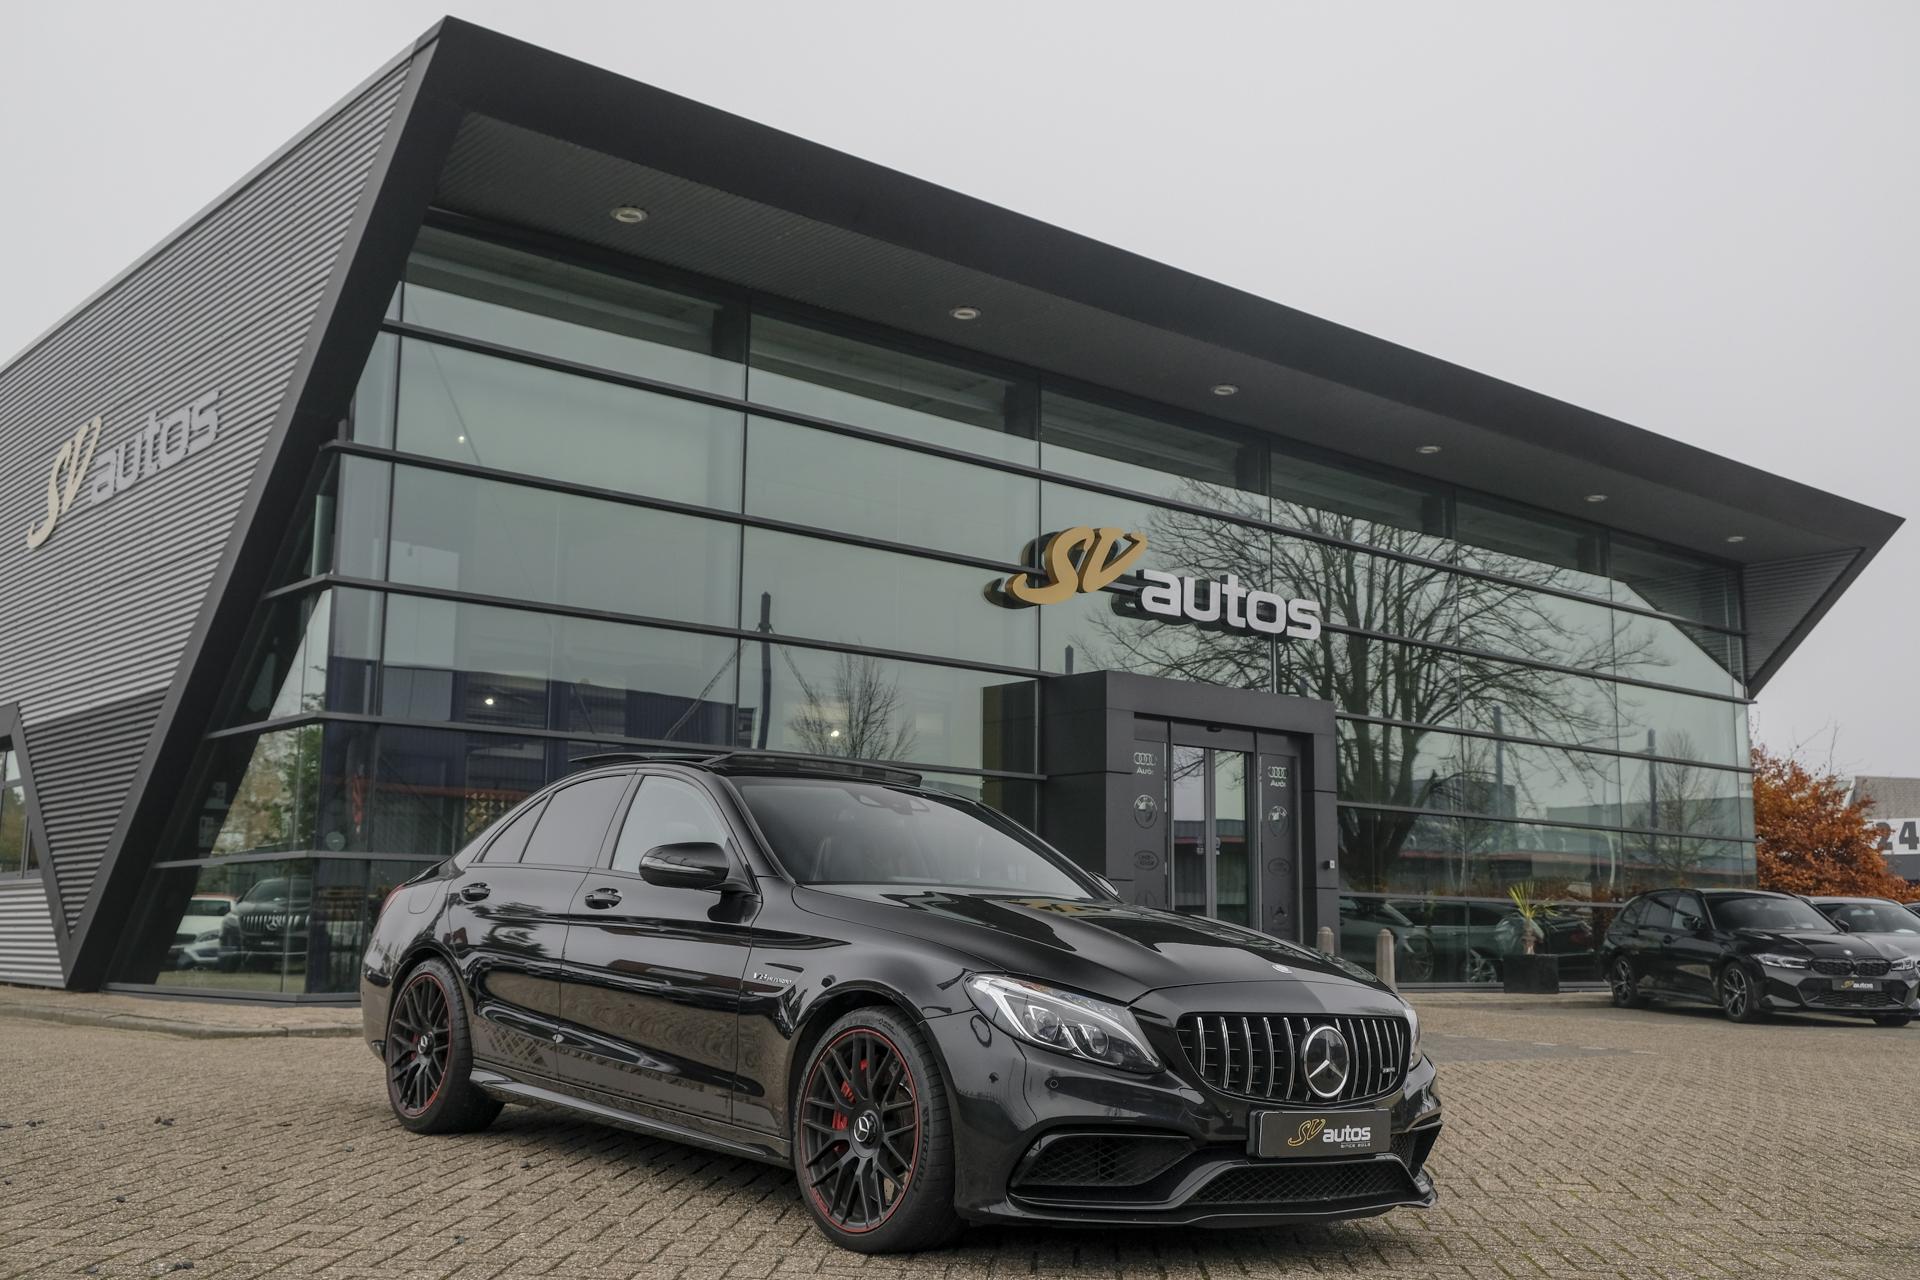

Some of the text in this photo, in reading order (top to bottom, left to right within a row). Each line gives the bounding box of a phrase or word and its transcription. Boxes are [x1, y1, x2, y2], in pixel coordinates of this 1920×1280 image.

[91, 390, 219, 505] autos
[1138, 568, 1322, 640] autos
[1322, 1124, 1371, 1143] autos
